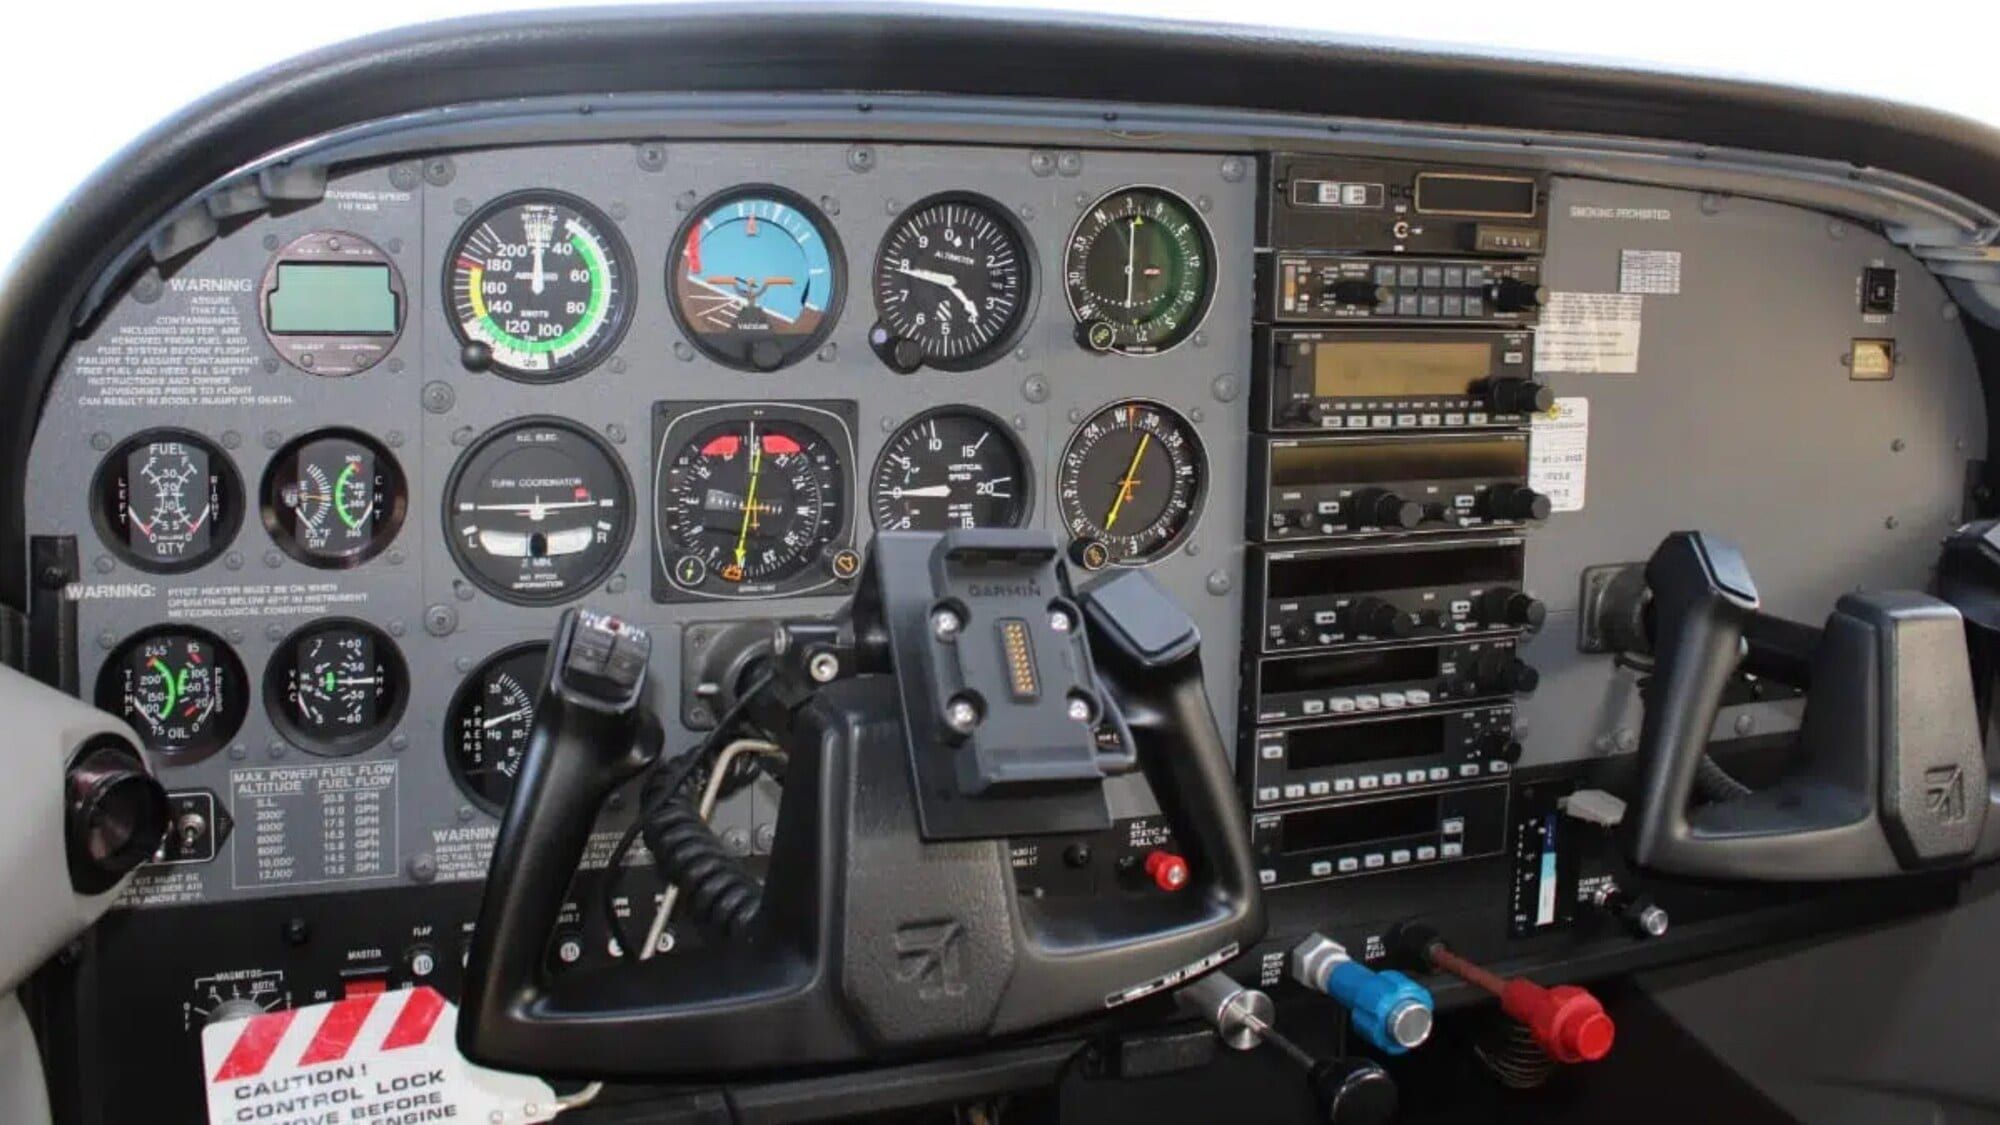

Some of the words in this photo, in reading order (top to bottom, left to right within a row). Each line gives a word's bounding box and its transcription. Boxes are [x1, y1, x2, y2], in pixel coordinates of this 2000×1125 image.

[1570, 207, 1615, 218] SMOKING
[1616, 208, 1671, 220] PROHIBITED
[944, 229, 954, 241] 0
[552, 242, 572, 254] 40
[919, 236, 929, 248] 9
[497, 243, 527, 257] 200
[934, 250, 975, 265] ALTIMETER
[486, 259, 512, 271] 180
[570, 271, 589, 282] 60
[171, 278, 253, 293] WARNING
[482, 282, 507, 294] 160
[899, 290, 909, 302] 7
[488, 301, 513, 313] 140
[566, 302, 586, 314] 80
[985, 298, 995, 309] 3
[191, 306, 214, 314] THAT
[916, 313, 925, 325] 6
[120, 326, 177, 335] INCLUDING
[220, 326, 241, 334] ARE
[505, 320, 530, 333] 120
[538, 324, 563, 336] 100
[941, 323, 950, 335] 5
[111, 336, 160, 345] REMOVED
[164, 336, 194, 345] FROM
[196, 336, 222, 345] FUEL
[226, 336, 248, 345] AND
[97, 346, 124, 355] FUEL
[127, 346, 168, 355] SYSTEM
[171, 346, 212, 355] BEFORE
[78, 356, 121, 365] FAILURE
[124, 356, 139, 365] TO
[142, 356, 183, 365] ASSURE
[76, 367, 104, 375] FREE
[106, 367, 132, 375] FUEL
[136, 367, 155, 375] AND
[192, 367, 209, 375] ALL
[212, 367, 250, 375] SAFETY
[88, 376, 164, 386] INSTRUCTIONS
[168, 376, 190, 385] AND
[192, 376, 231, 385] OWNER
[100, 386, 162, 395] ADVISORIES
[164, 386, 196, 395] PRIOR
[199, 386, 215, 395] TO
[216, 386, 253, 395] FLIGHT
[78, 397, 101, 406] CAN
[103, 397, 143, 406] RESULT
[146, 396, 158, 406] IN
[160, 396, 199, 405] BODILY
[202, 395, 238, 405] INJURY
[240, 395, 256, 405] OR
[1145, 413, 1159, 427] 30
[1084, 423, 1099, 438] 24
[149, 443, 186, 455] FUEL
[928, 439, 942, 451] 10
[962, 445, 976, 457] 15
[149, 457, 157, 466] F
[902, 457, 910, 470] 5
[162, 468, 177, 478] 30
[492, 480, 515, 488] TURN
[519, 478, 582, 487] COORDINATOR
[976, 482, 994, 495] 20
[118, 477, 126, 524] LEFT
[210, 476, 218, 522] RIGHT
[374, 476, 382, 520] CHT
[961, 517, 975, 530] 15
[468, 536, 478, 548] L
[597, 532, 607, 543] R
[156, 543, 185, 555] QTY
[66, 583, 156, 600] WARNING:
[202, 587, 239, 596] HEATER
[243, 586, 270, 595] MUST
[273, 585, 287, 594] BE
[289, 585, 306, 594] ON
[308, 584, 337, 593] WHEN
[968, 584, 1041, 597] GARMIN
[168, 597, 226, 607] OPERATING
[230, 596, 264, 606] BELOW
[292, 595, 302, 604] IN
[305, 592, 367, 603] INSTRUMENT
[168, 607, 259, 618] METEOROLOGICAL
[338, 639, 362, 649] +60
[144, 645, 167, 656] 245
[350, 662, 365, 672] 30
[191, 669, 208, 678] 100
[140, 675, 161, 685] 200
[288, 669, 297, 702] VAC
[124, 669, 133, 716] TEMP
[187, 682, 201, 692] 60
[195, 698, 208, 708] 20
[151, 725, 165, 736] 75
[167, 727, 189, 739] OIL
[191, 723, 199, 733] 0
[473, 705, 482, 763] PRESS
[463, 718, 472, 753] MAN
[486, 729, 502, 740] Hg
[233, 772, 266, 783] MAX.
[269, 769, 318, 780] POWER
[322, 766, 355, 778] FUEL
[358, 764, 395, 776] FLOW
[238, 780, 302, 793] ALTITUDE
[318, 777, 352, 789] FUEL
[355, 775, 392, 787] FLOW
[354, 791, 379, 802] GPH
[354, 803, 379, 814] GPH
[323, 817, 345, 829] 17.5
[354, 815, 379, 826] GPH
[354, 827, 379, 838] GPH
[433, 825, 499, 842] WARNIN
[1130, 828, 1157, 838] STATIC
[354, 839, 379, 850] GPH
[436, 843, 471, 853] ASSURE
[1130, 837, 1153, 847] PULL
[323, 853, 345, 864] 14.5
[354, 850, 379, 862] GPH
[354, 862, 379, 874] GPH
[139, 884, 183, 894] OUTSIDE
[144, 893, 177, 904] ABOVE
[412, 926, 433, 936] FLAP
[348, 949, 382, 960] MASTER
[415, 959, 430, 971] 10
[251, 981, 275, 991] BOTH
[234, 1063, 367, 1100] CAUTION!
[236, 1087, 364, 1122] CONTROL
[376, 1069, 445, 1095] LOCK
[351, 1091, 443, 1119] BEFORE
